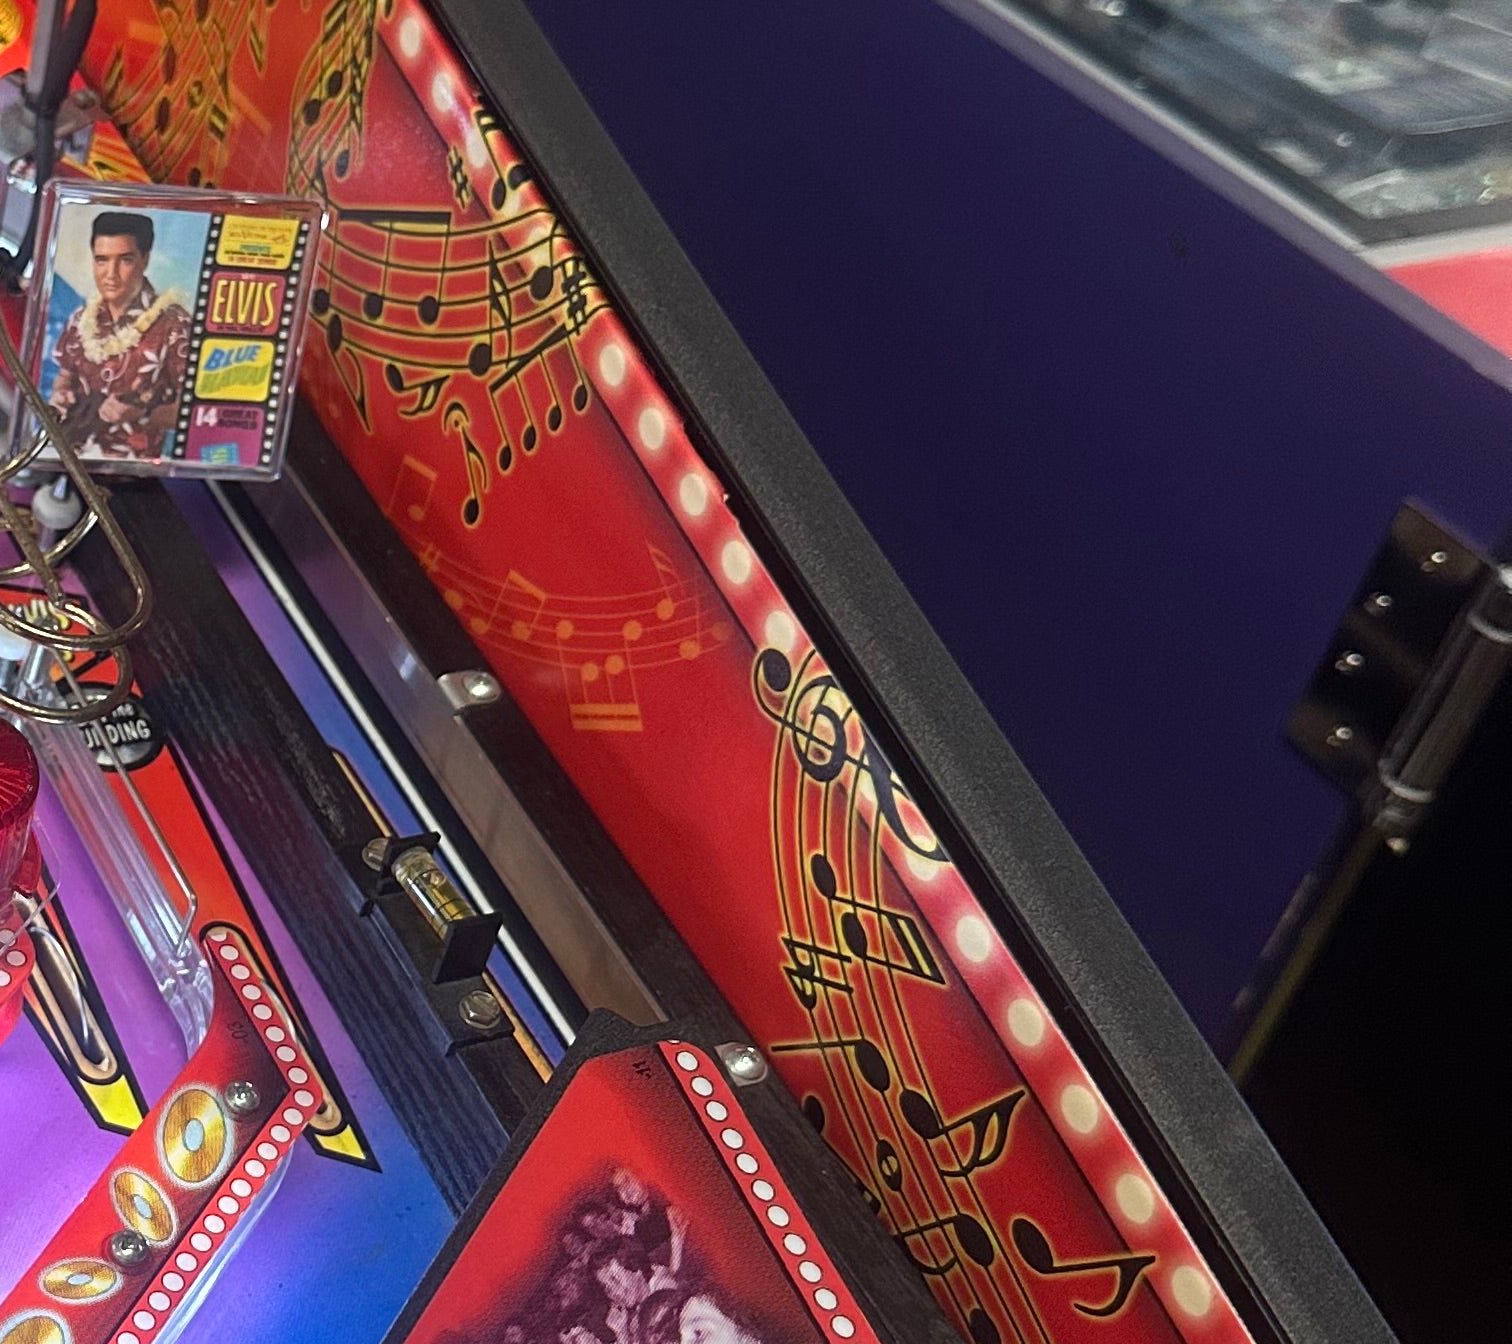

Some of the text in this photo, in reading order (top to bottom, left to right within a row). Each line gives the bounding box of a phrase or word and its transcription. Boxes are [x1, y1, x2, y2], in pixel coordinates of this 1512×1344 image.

[211, 280, 278, 326] ELVIS
[203, 344, 262, 371] BLUE
[196, 407, 218, 427] 14
